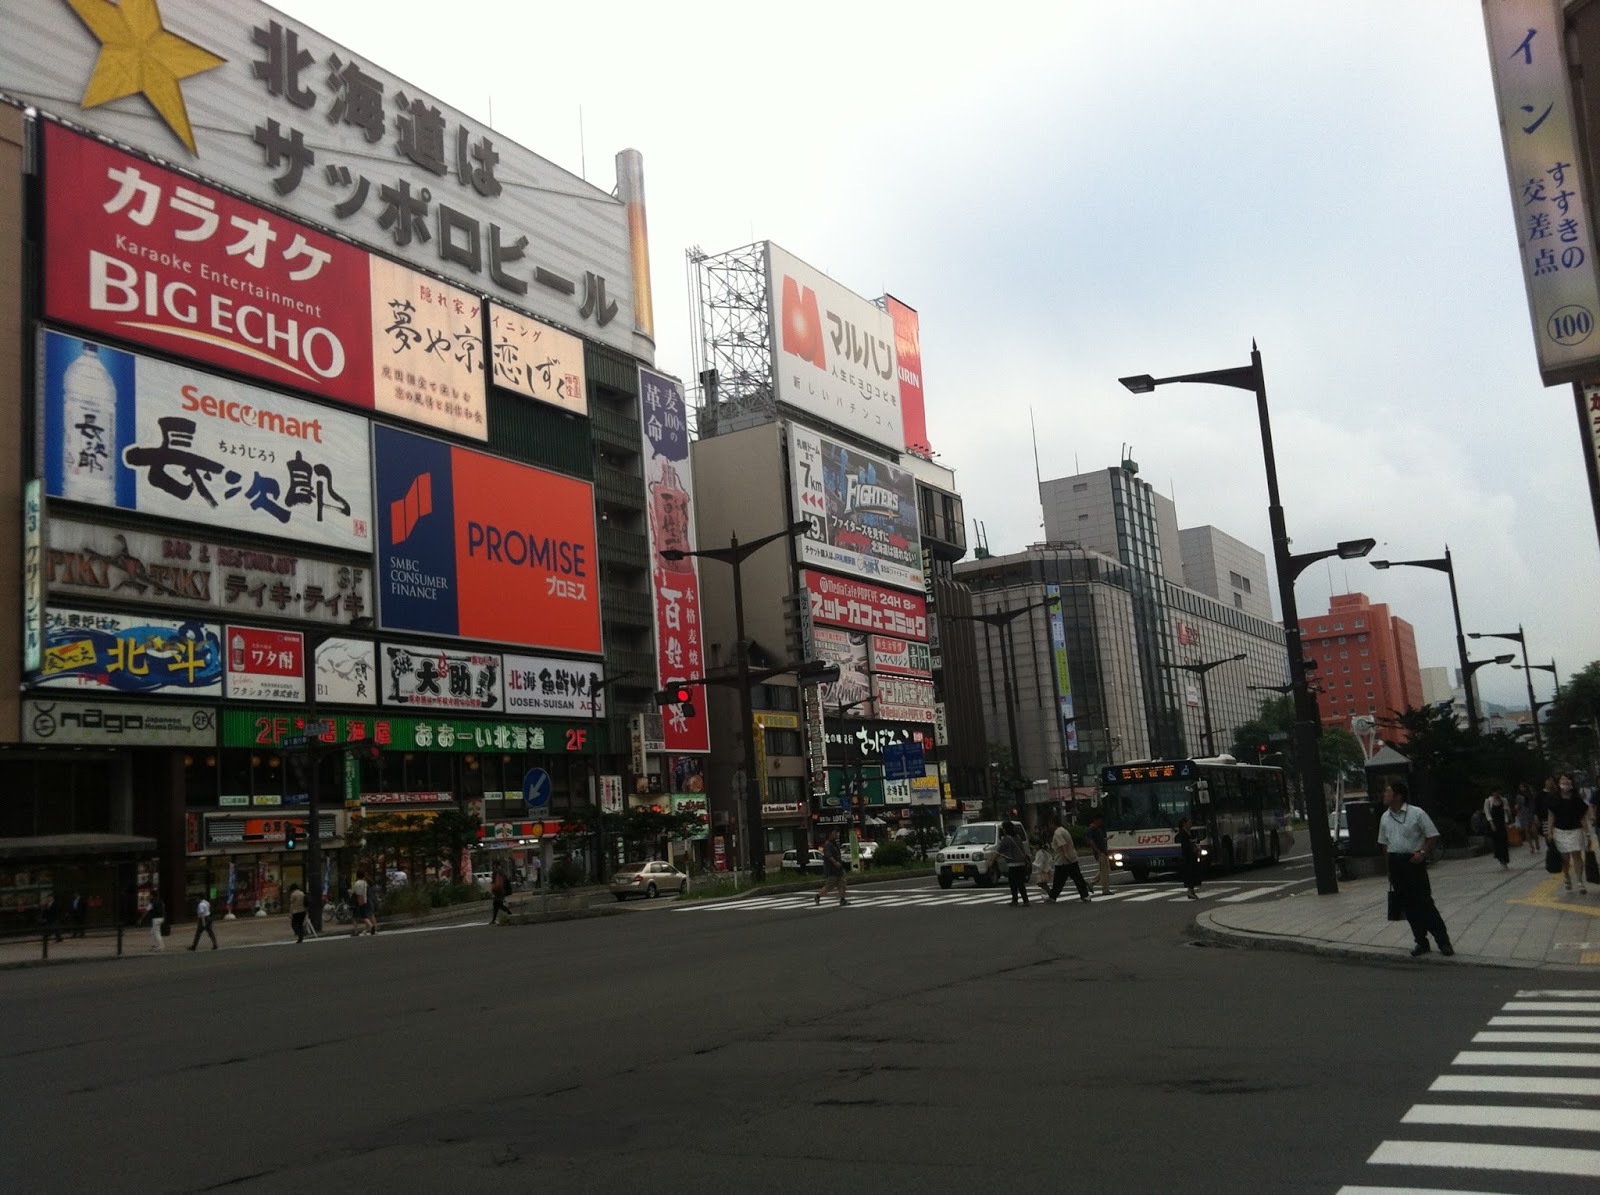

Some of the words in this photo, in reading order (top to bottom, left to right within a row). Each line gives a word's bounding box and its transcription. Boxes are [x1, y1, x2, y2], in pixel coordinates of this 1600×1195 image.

[252, 19, 503, 197] 北海道は
[103, 167, 332, 281] カラオケ
[1521, 178, 1559, 277] 交差点
[1547, 162, 1586, 270] すすきの
[115, 234, 192, 273] Karaoke
[200, 263, 322, 318] Entertainment
[89, 250, 198, 324] BIG
[210, 294, 346, 378] ECHO
[1552, 310, 1590, 340] 100
[826, 310, 894, 381] マルハン
[180, 385, 323, 443] Seicomart
[644, 383, 663, 442] 革命
[124, 416, 351, 524] 長次郎
[218, 439, 276, 463] ちょうじろう
[844, 473, 900, 515] FIGHTERS
[390, 556, 420, 572] SMBC
[467, 521, 586, 578] PROMISE
[390, 569, 449, 590] CONSUMER
[390, 583, 438, 601] FINANCE
[546, 575, 587, 601] プロミス
[810, 591, 927, 638] ネットカフェコミック
[879, 593, 902, 609] 24H
[105, 636, 206, 684] 北斗
[251, 649, 294, 670] ワタ酎
[415, 658, 473, 698] 大助
[909, 646, 929, 670] 青汁
[317, 683, 329, 696] B1
[509, 696, 575, 710] UOSEN-SUISAN
[255, 717, 289, 744] 2F
[565, 729, 588, 751] 2F
